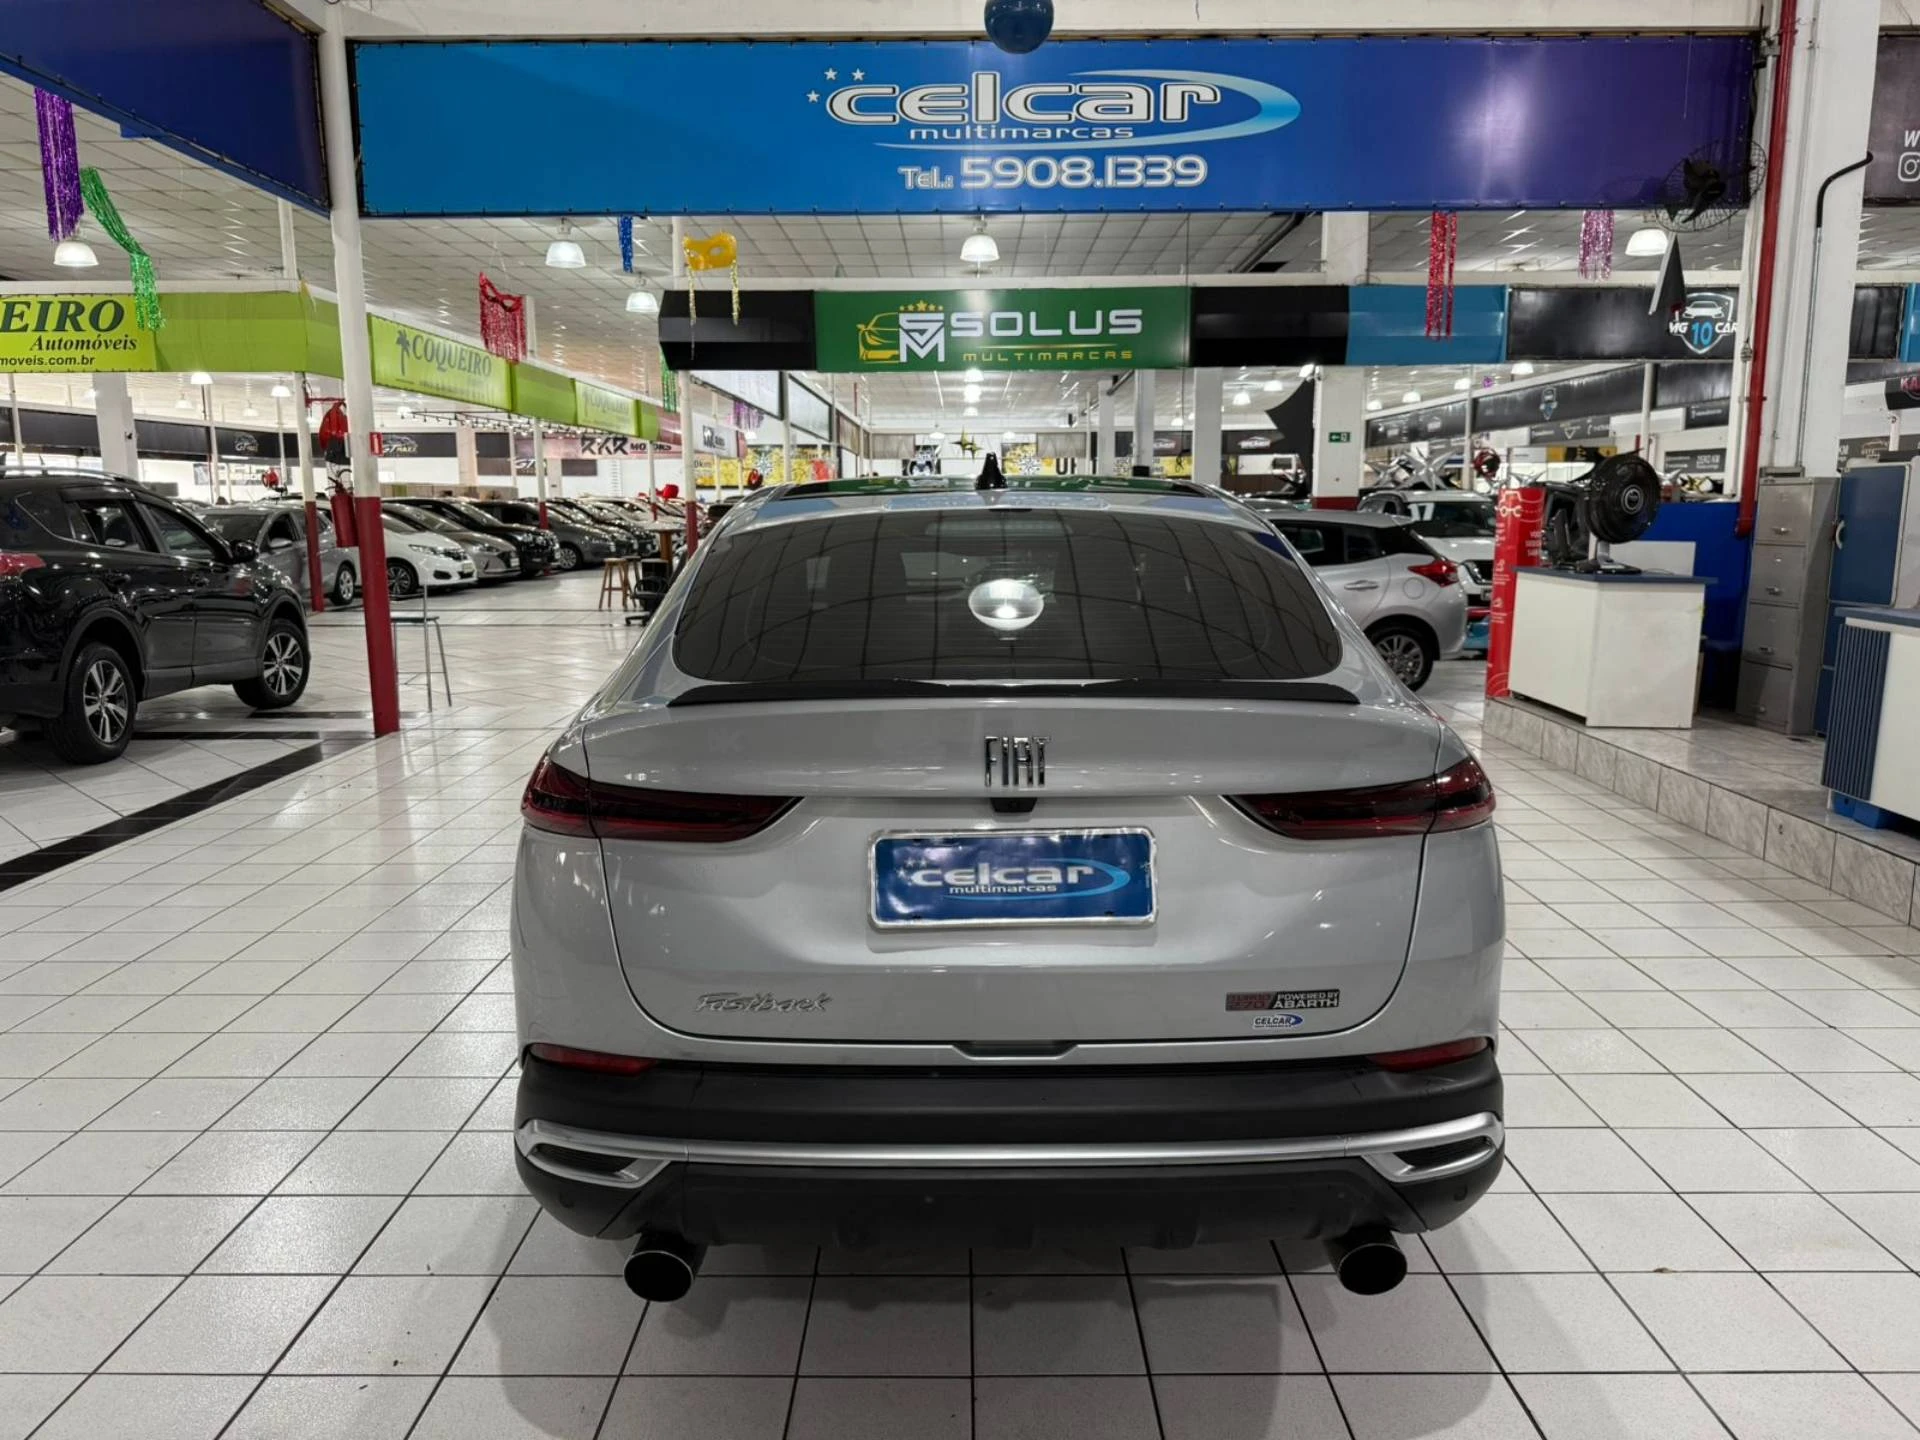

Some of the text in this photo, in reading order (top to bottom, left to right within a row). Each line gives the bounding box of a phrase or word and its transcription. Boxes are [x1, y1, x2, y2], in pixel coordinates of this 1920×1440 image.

[826, 71, 1221, 124] celcar
[909, 124, 1133, 139] multimarcas
[961, 155, 1208, 190] 5908.1339
[951, 309, 1142, 337] SOLUS
[30, 334, 137, 351] Automóveis
[1692, 321, 1713, 346] 10
[412, 334, 492, 378] COQUEIRO
[963, 351, 1132, 361] MULTIMARCAS
[985, 736, 1049, 787] FIAT
[911, 863, 1094, 886] celcar
[950, 884, 1057, 894] multimarcas
[696, 992, 834, 1012] Fastback
[1273, 999, 1338, 1009] ABARTH
[1278, 992, 1327, 1000] POWERED
[1254, 1017, 1293, 1025] CELCAR
